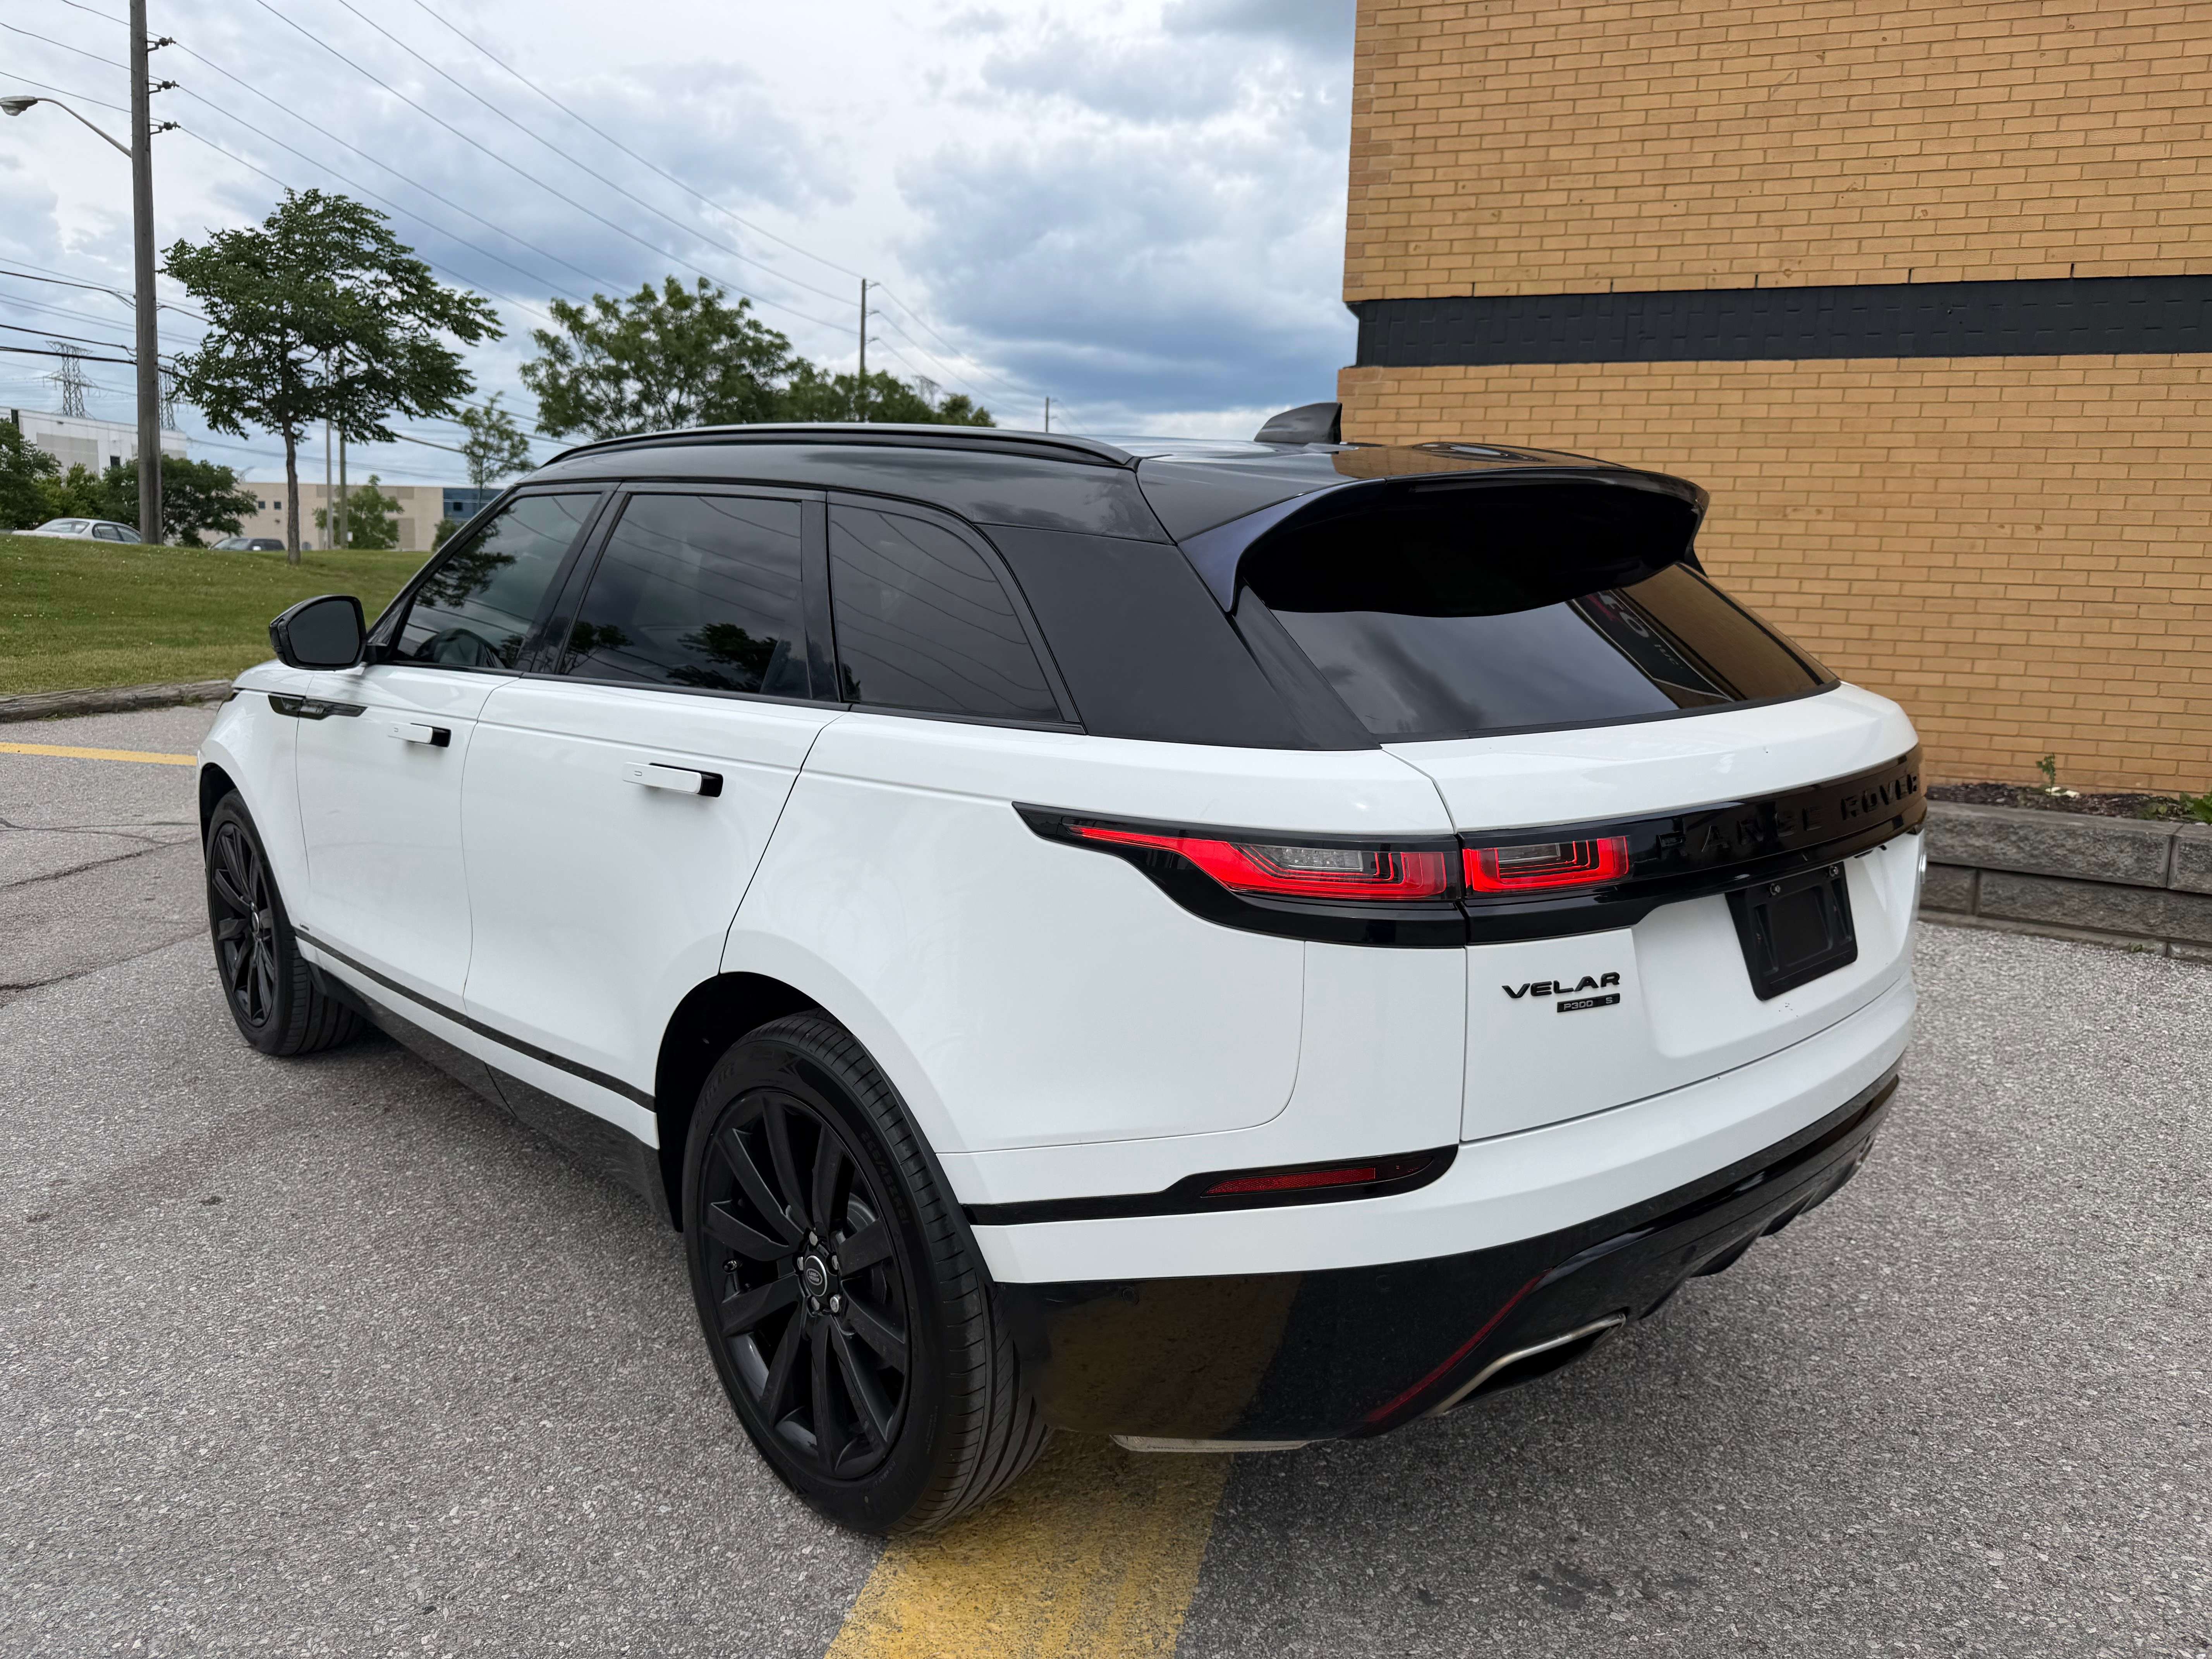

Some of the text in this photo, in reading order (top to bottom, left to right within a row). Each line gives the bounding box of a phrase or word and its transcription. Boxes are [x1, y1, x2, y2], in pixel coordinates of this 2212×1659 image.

[1656, 774, 1917, 860] RANGE ROVER
[1501, 972, 1620, 998] VELAR
[1563, 1000, 1594, 1011] P300
